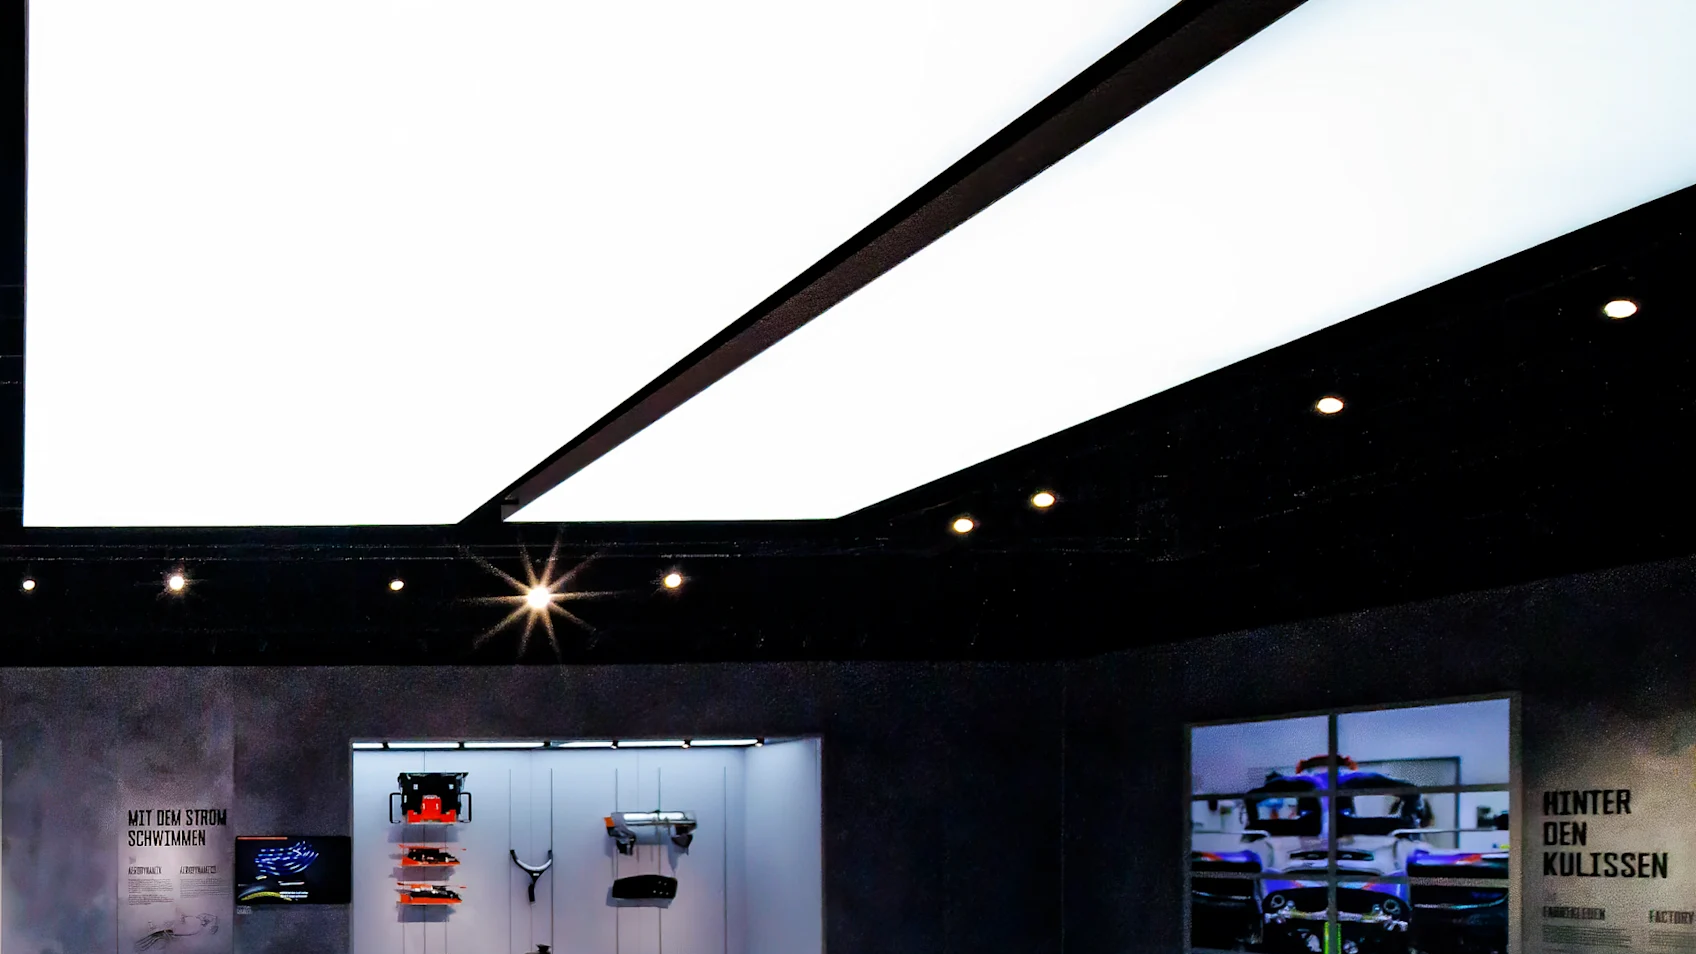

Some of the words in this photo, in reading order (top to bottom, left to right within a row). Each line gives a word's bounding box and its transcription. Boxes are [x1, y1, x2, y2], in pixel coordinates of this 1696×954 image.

[1543, 789, 1631, 816] HINTER
[128, 809, 152, 826] MIT
[157, 809, 181, 826] DEM
[186, 809, 227, 826] STROM
[128, 830, 206, 847] SCHWIMMEN
[1543, 821, 1587, 846] DEN
[1543, 852, 1668, 878] KULISSEN
